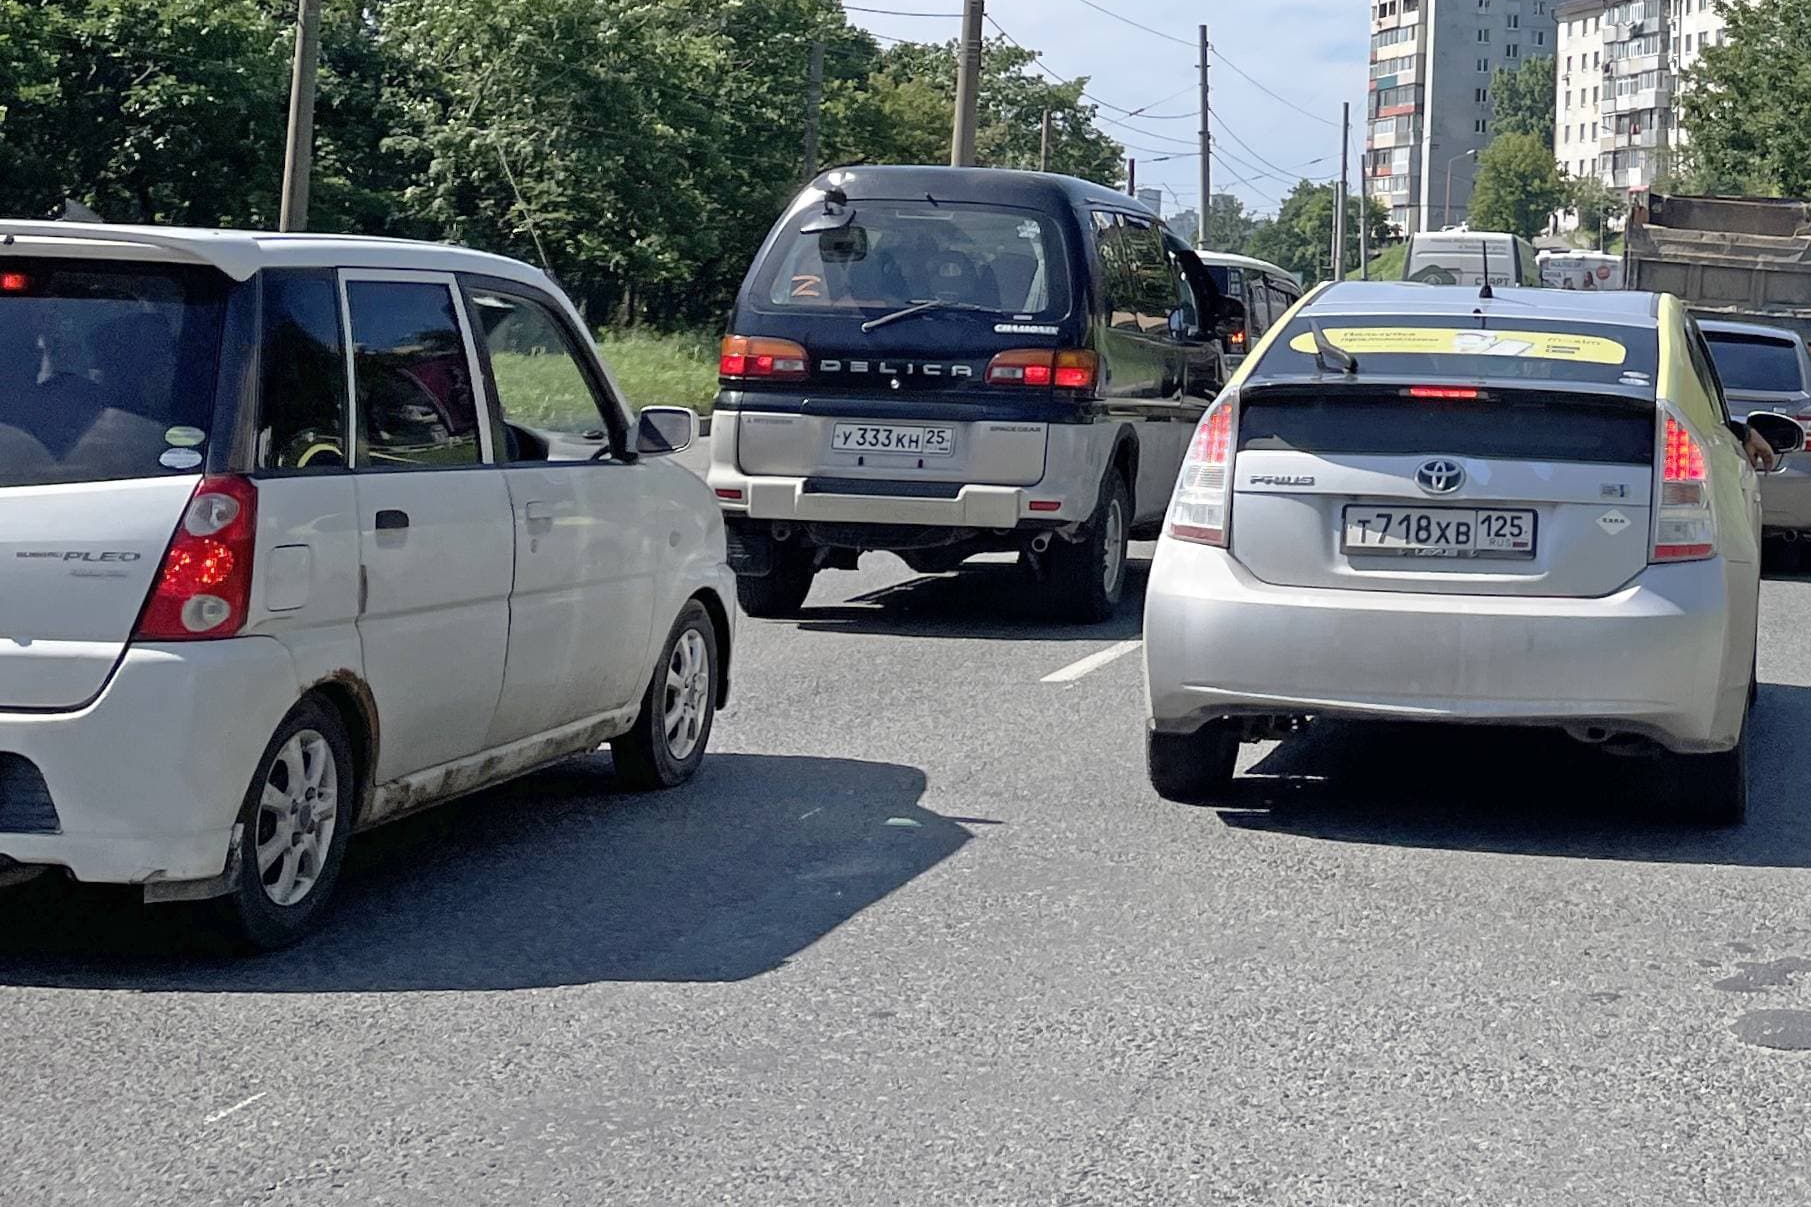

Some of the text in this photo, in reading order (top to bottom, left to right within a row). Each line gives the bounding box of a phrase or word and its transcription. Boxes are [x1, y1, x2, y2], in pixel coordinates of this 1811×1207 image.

[791, 275, 821, 297] Z
[820, 359, 972, 377] DELICA
[925, 429, 945, 444] 25
[1480, 514, 1524, 538] 125
[1488, 537, 1513, 548] RUS
[63, 551, 141, 561] PLEO
